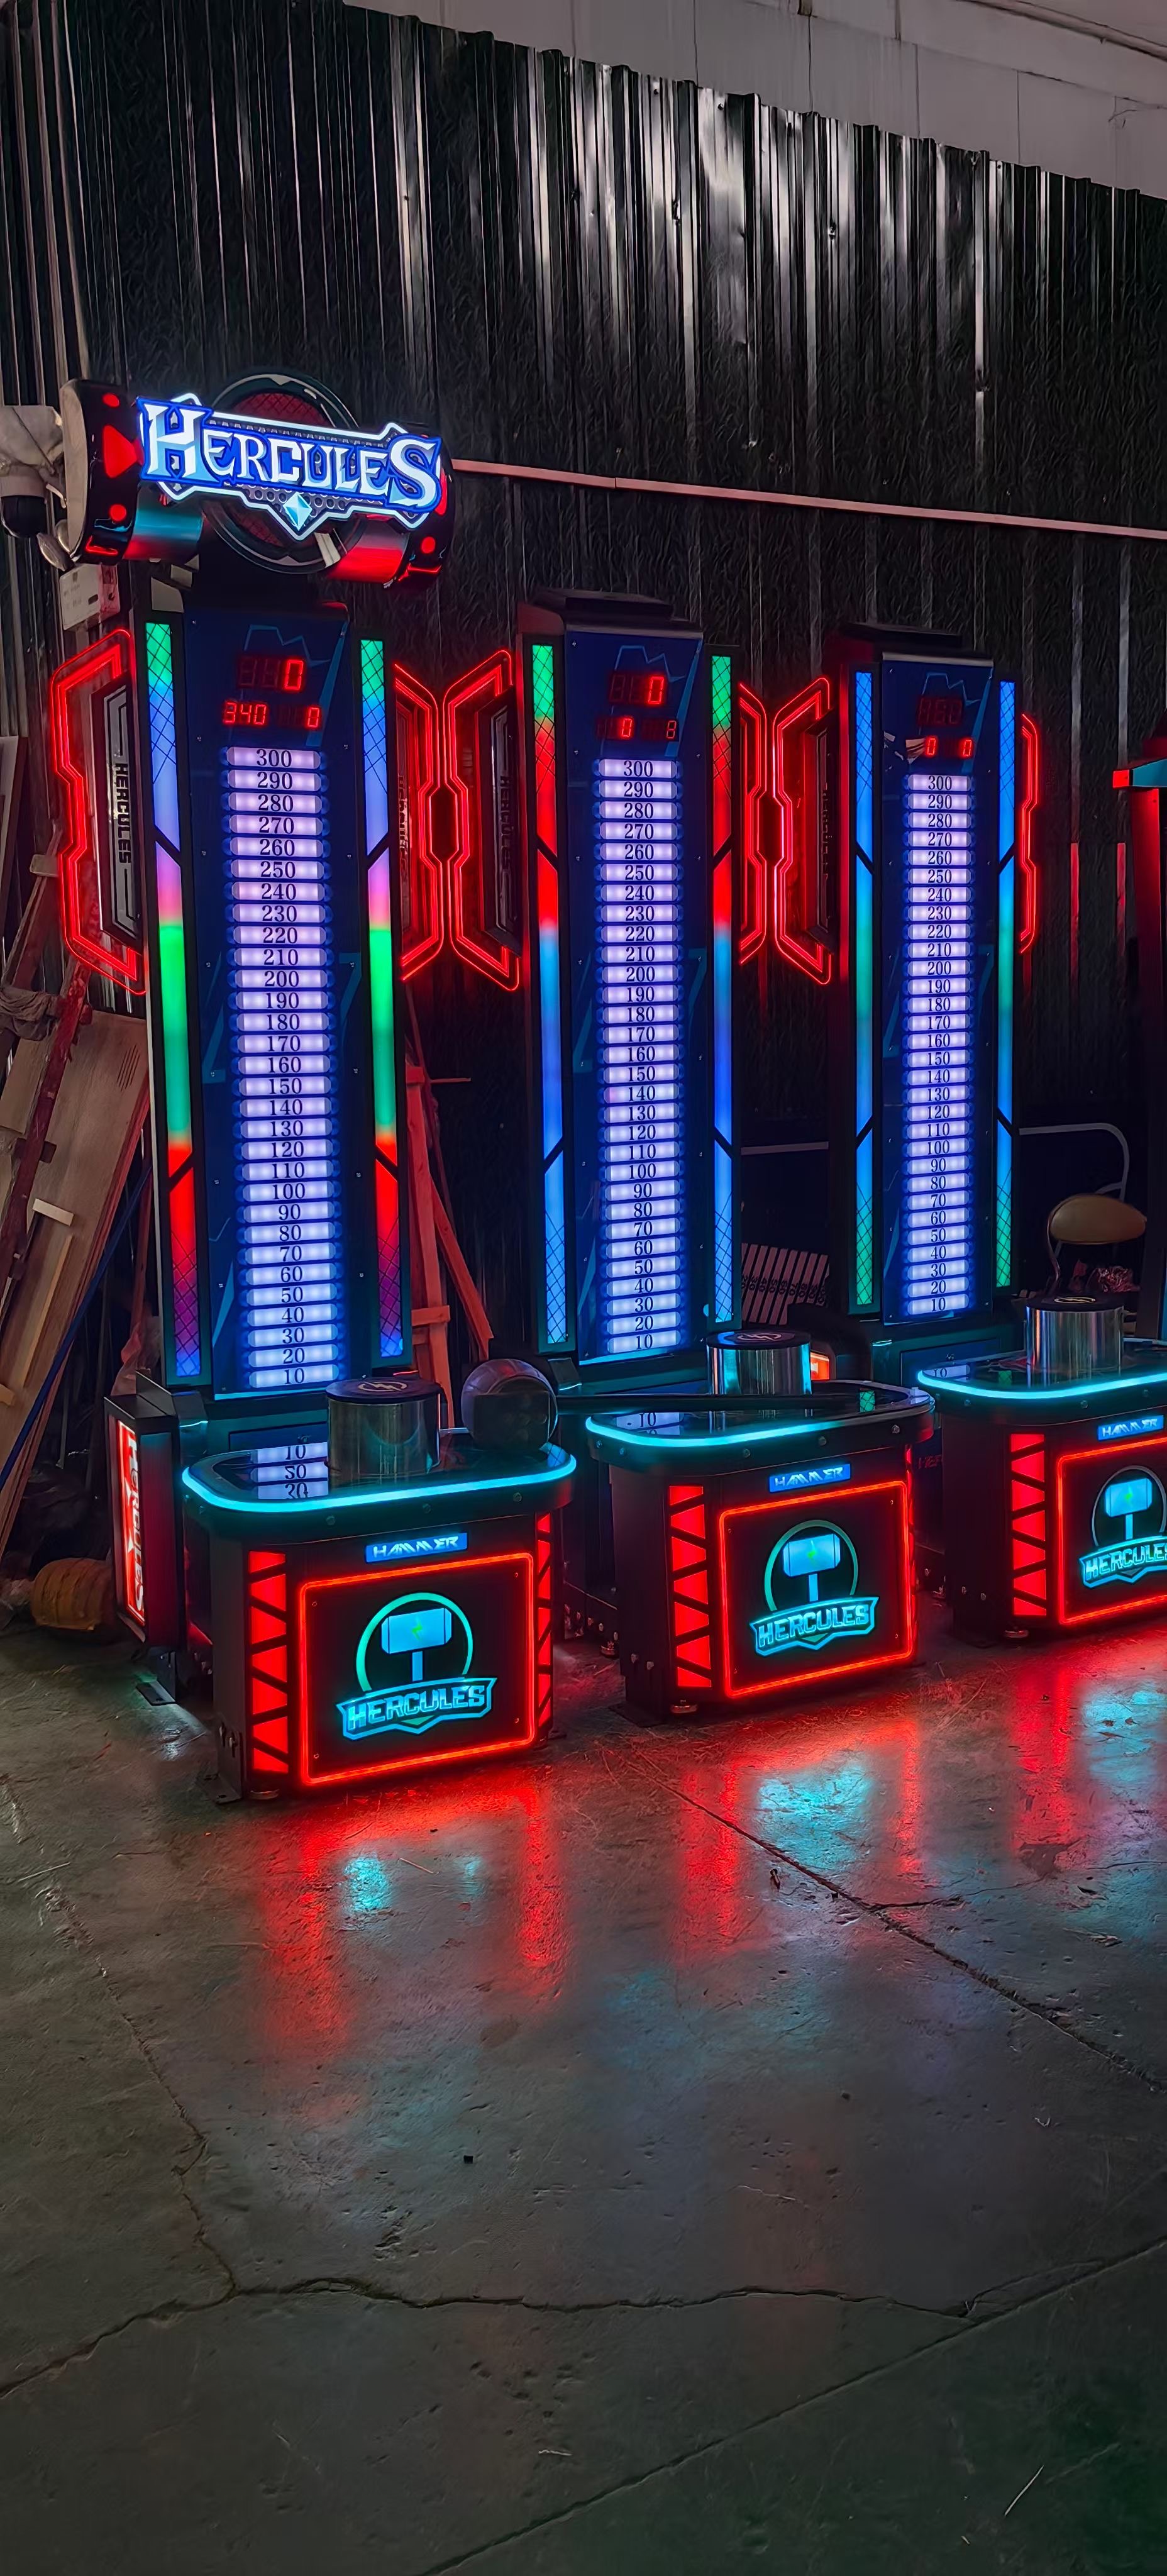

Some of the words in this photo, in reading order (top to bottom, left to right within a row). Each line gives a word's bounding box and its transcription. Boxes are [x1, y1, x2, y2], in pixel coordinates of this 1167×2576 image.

[140, 400, 440, 510] HERCULES
[285, 660, 303, 690] 0
[648, 676, 664, 704] 0
[224, 702, 267, 724] 340
[307, 707, 319, 728] 0
[622, 718, 633, 737] 0
[927, 738, 936, 755] 0
[963, 740, 971, 757] 0
[256, 749, 292, 767] 300
[623, 760, 653, 777] 300
[257, 772, 293, 789] 290
[928, 776, 952, 790] 300
[624, 782, 653, 798] 290
[258, 794, 294, 811] 280
[928, 795, 952, 809] 290
[115, 763, 131, 863] HERCULES
[624, 802, 654, 819] 280
[258, 816, 294, 833] 270
[928, 813, 952, 828] 280
[624, 823, 654, 840] 270
[927, 832, 952, 846] 270
[260, 839, 295, 855] 260
[624, 844, 654, 860] 260
[927, 850, 952, 865] 260
[260, 861, 296, 877] 250
[624, 865, 655, 880] 250
[927, 869, 952, 883] 250
[261, 883, 297, 899] 240
[625, 885, 655, 901] 240
[927, 887, 952, 902] 240
[262, 905, 297, 921] 230
[625, 906, 655, 921] 230
[927, 906, 952, 920] 230
[263, 927, 298, 943] 220
[626, 926, 655, 941] 220
[927, 924, 951, 938] 220
[263, 949, 299, 965] 210
[626, 946, 655, 962] 210
[927, 943, 951, 957] 210
[626, 966, 655, 982] 200
[927, 961, 951, 975] 200
[264, 970, 299, 987] 200
[928, 979, 951, 993] 190
[267, 992, 299, 1008] 190
[628, 986, 655, 1002] 190
[928, 997, 951, 1011] 180
[628, 1006, 655, 1022] 180
[267, 1014, 300, 1030] 180
[927, 1015, 951, 1030] 170
[628, 1026, 655, 1042] 170
[927, 1033, 951, 1047] 160
[268, 1035, 301, 1051] 170
[628, 1046, 656, 1062] 160
[927, 1052, 950, 1065] 150
[268, 1057, 301, 1072] 160
[628, 1066, 656, 1081] 150
[927, 1069, 950, 1083] 140
[269, 1078, 302, 1094] 150
[629, 1085, 656, 1101] 140
[927, 1087, 950, 1101] 130
[270, 1099, 302, 1115] 140
[629, 1105, 656, 1121] 130
[927, 1105, 950, 1119] 120
[270, 1121, 303, 1136] 130
[629, 1124, 656, 1140] 120
[927, 1123, 950, 1136] 110
[271, 1141, 304, 1157] 120
[629, 1144, 656, 1159] 110
[927, 1140, 950, 1154] 100
[272, 1163, 305, 1178] 110
[629, 1163, 656, 1179] 100
[931, 1158, 946, 1172] 90
[931, 1175, 946, 1189] 80
[273, 1184, 306, 1199] 100
[633, 1183, 653, 1198] 90
[931, 1193, 946, 1207] 70
[279, 1204, 301, 1219] 90
[633, 1202, 653, 1217] 80
[931, 1211, 946, 1224] 60
[279, 1225, 301, 1240] 80
[634, 1221, 653, 1236] 70
[931, 1228, 946, 1241] 50
[280, 1246, 302, 1261] 70
[634, 1240, 653, 1255] 60
[931, 1245, 946, 1259] 40
[634, 1259, 653, 1274] 50
[931, 1263, 946, 1276] 30
[280, 1267, 303, 1282] 60
[634, 1278, 653, 1293] 40
[931, 1280, 946, 1294] 20
[281, 1287, 304, 1302] 50
[634, 1297, 653, 1312] 30
[931, 1297, 946, 1311] 10
[282, 1307, 304, 1323] 40
[635, 1315, 654, 1330] 20
[283, 1328, 305, 1343] 30
[636, 1334, 653, 1349] 10
[284, 1348, 306, 1363] 20
[285, 1368, 305, 1384] 10
[1102, 1418, 1158, 1437] HAMMER
[775, 1467, 843, 1486] HAMMER
[373, 1536, 458, 1557] HAMMER
[1086, 1543, 1167, 1580] HERCULE
[759, 1604, 868, 1647] HERCULES
[348, 1685, 485, 1731] HERCULES
